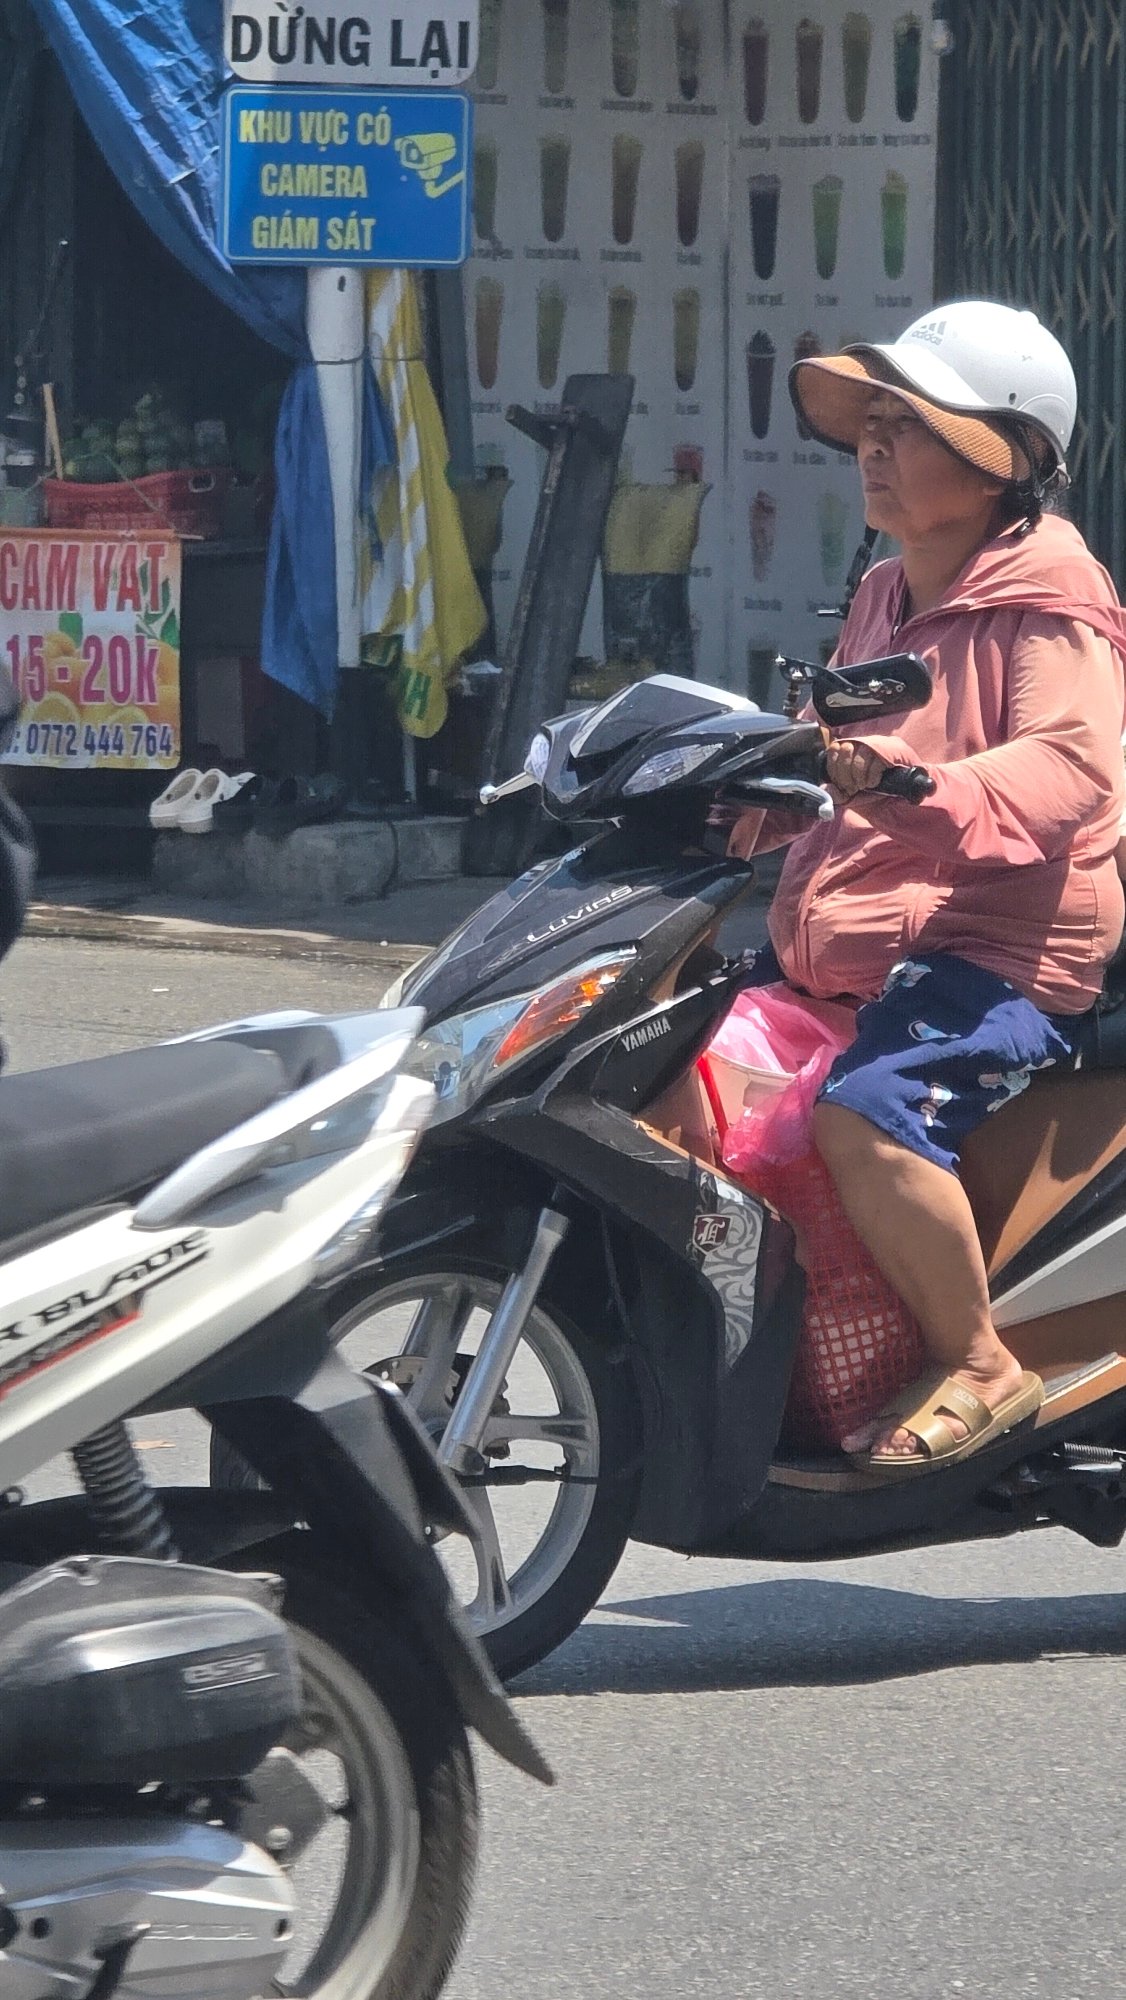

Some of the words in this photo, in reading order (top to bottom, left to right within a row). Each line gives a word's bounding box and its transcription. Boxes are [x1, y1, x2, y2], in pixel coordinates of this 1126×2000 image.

[231, 2, 371, 66] DỪNG
[390, 19, 470, 78] LẠI
[239, 110, 291, 143] KHU
[299, 109, 349, 151] VỰC
[356, 106, 391, 145] CÓ
[261, 164, 368, 198] CAMERA
[252, 210, 319, 249] GIÁM
[326, 211, 376, 250] SÁT
[911, 329, 943, 346] adidas
[0, 542, 80, 611] CAM
[26, 723, 77, 755] 0772
[84, 724, 124, 756] 444
[131, 724, 172, 756] 764
[527, 885, 633, 942] LUVIAS
[621, 1016, 671, 1052] YAMAHA
[30, 1228, 210, 1326] BLADE
